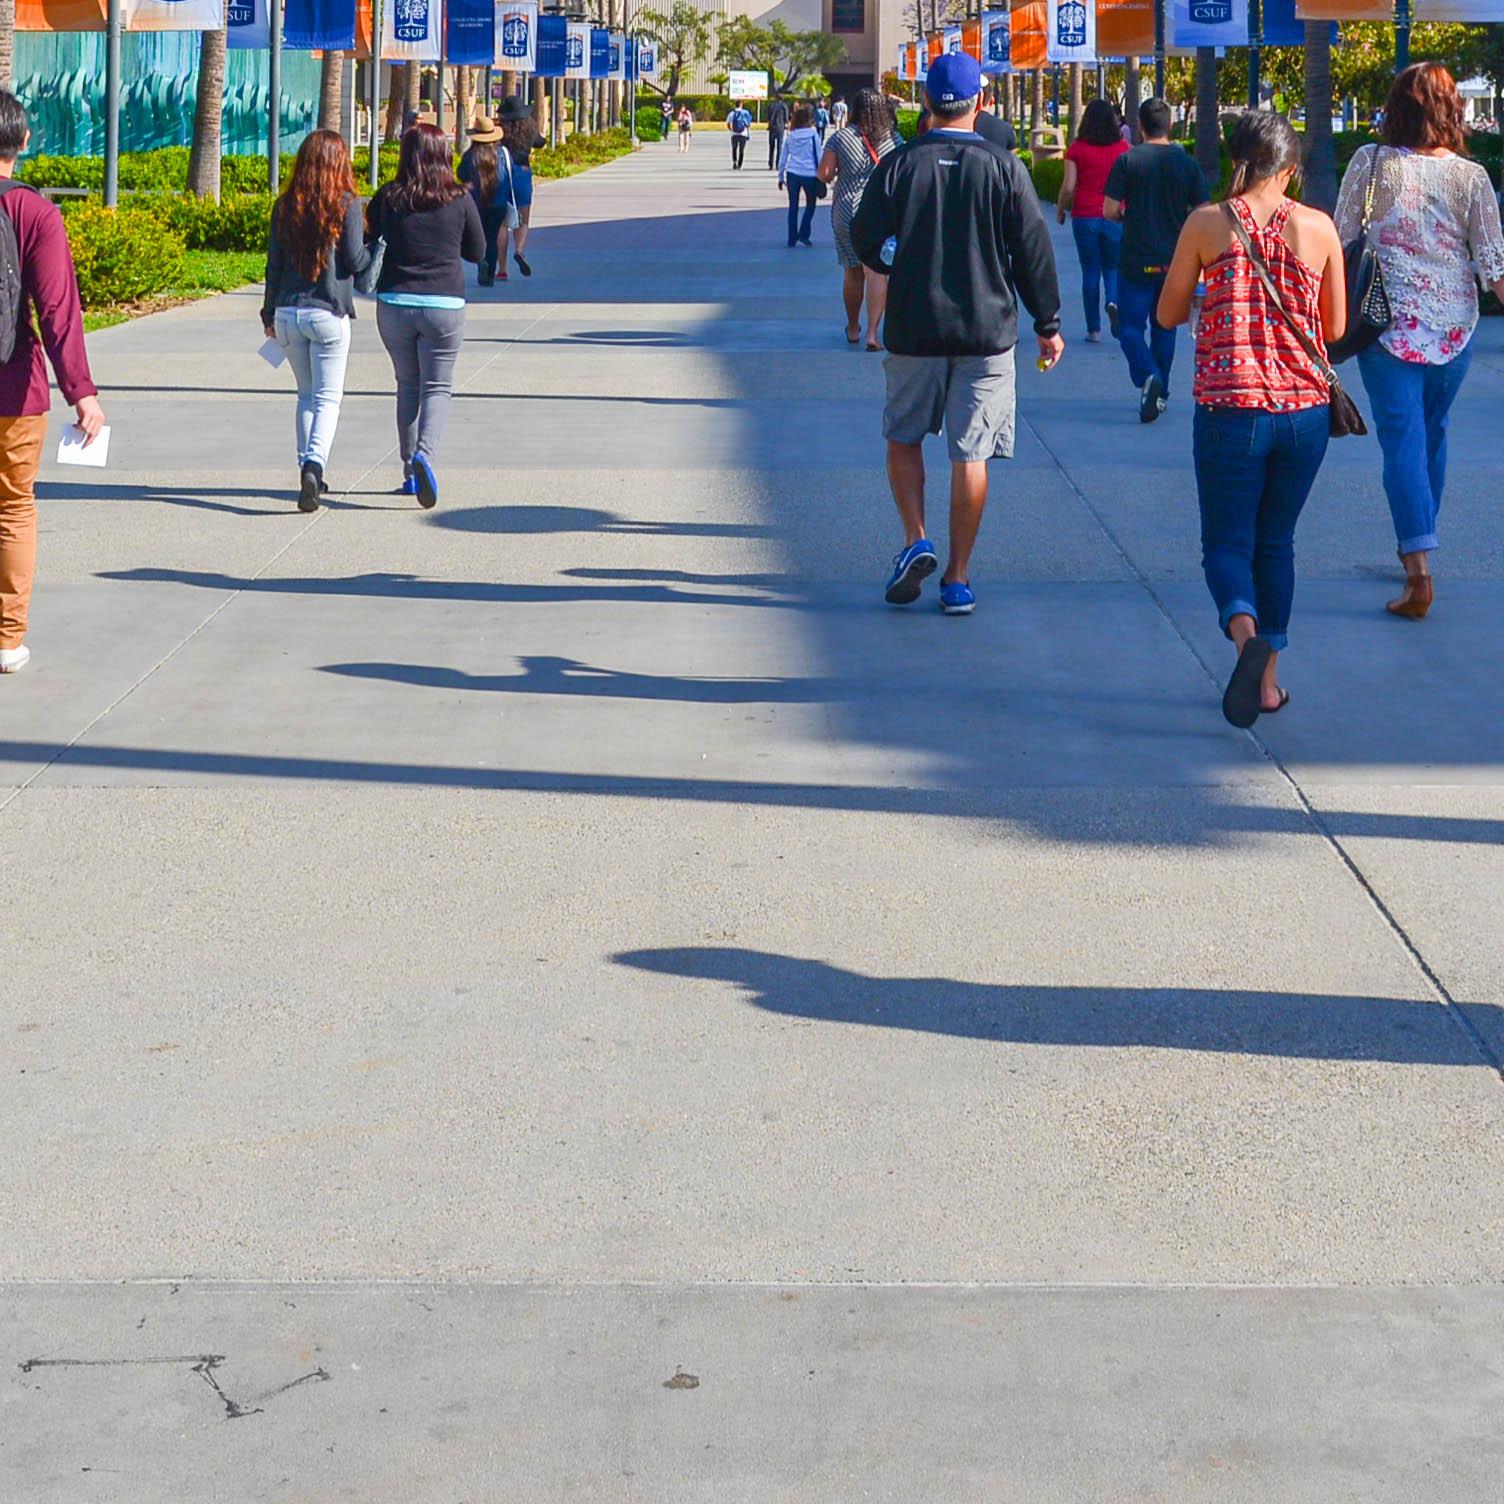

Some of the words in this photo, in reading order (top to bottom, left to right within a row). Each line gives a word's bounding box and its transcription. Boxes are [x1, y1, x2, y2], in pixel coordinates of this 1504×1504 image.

[227, 10, 251, 21] SUF
[1193, 7, 1228, 19] CSUF
[397, 27, 425, 38] CSUF
[1060, 35, 1084, 44] CSUF
